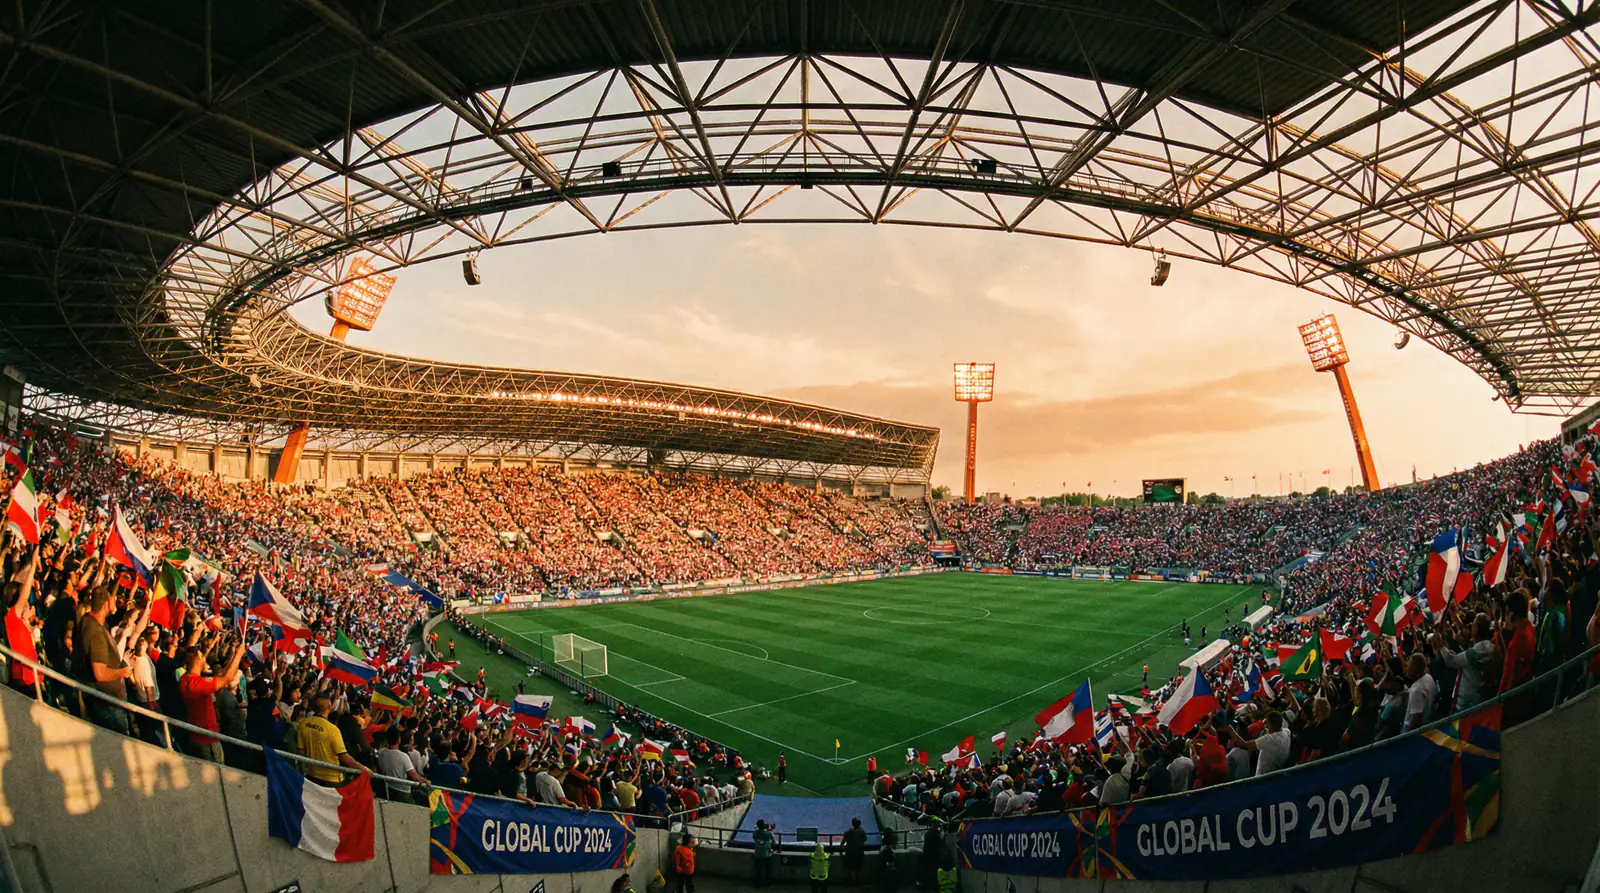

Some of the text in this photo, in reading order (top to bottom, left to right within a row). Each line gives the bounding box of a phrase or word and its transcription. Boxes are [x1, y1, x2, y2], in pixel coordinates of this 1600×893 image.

[1137, 777, 1397, 857] GLOBAL CUP 2024
[481, 819, 612, 853] GLOBAL CUP 2024
[972, 831, 1061, 858] GLOBAL CUP 2024
